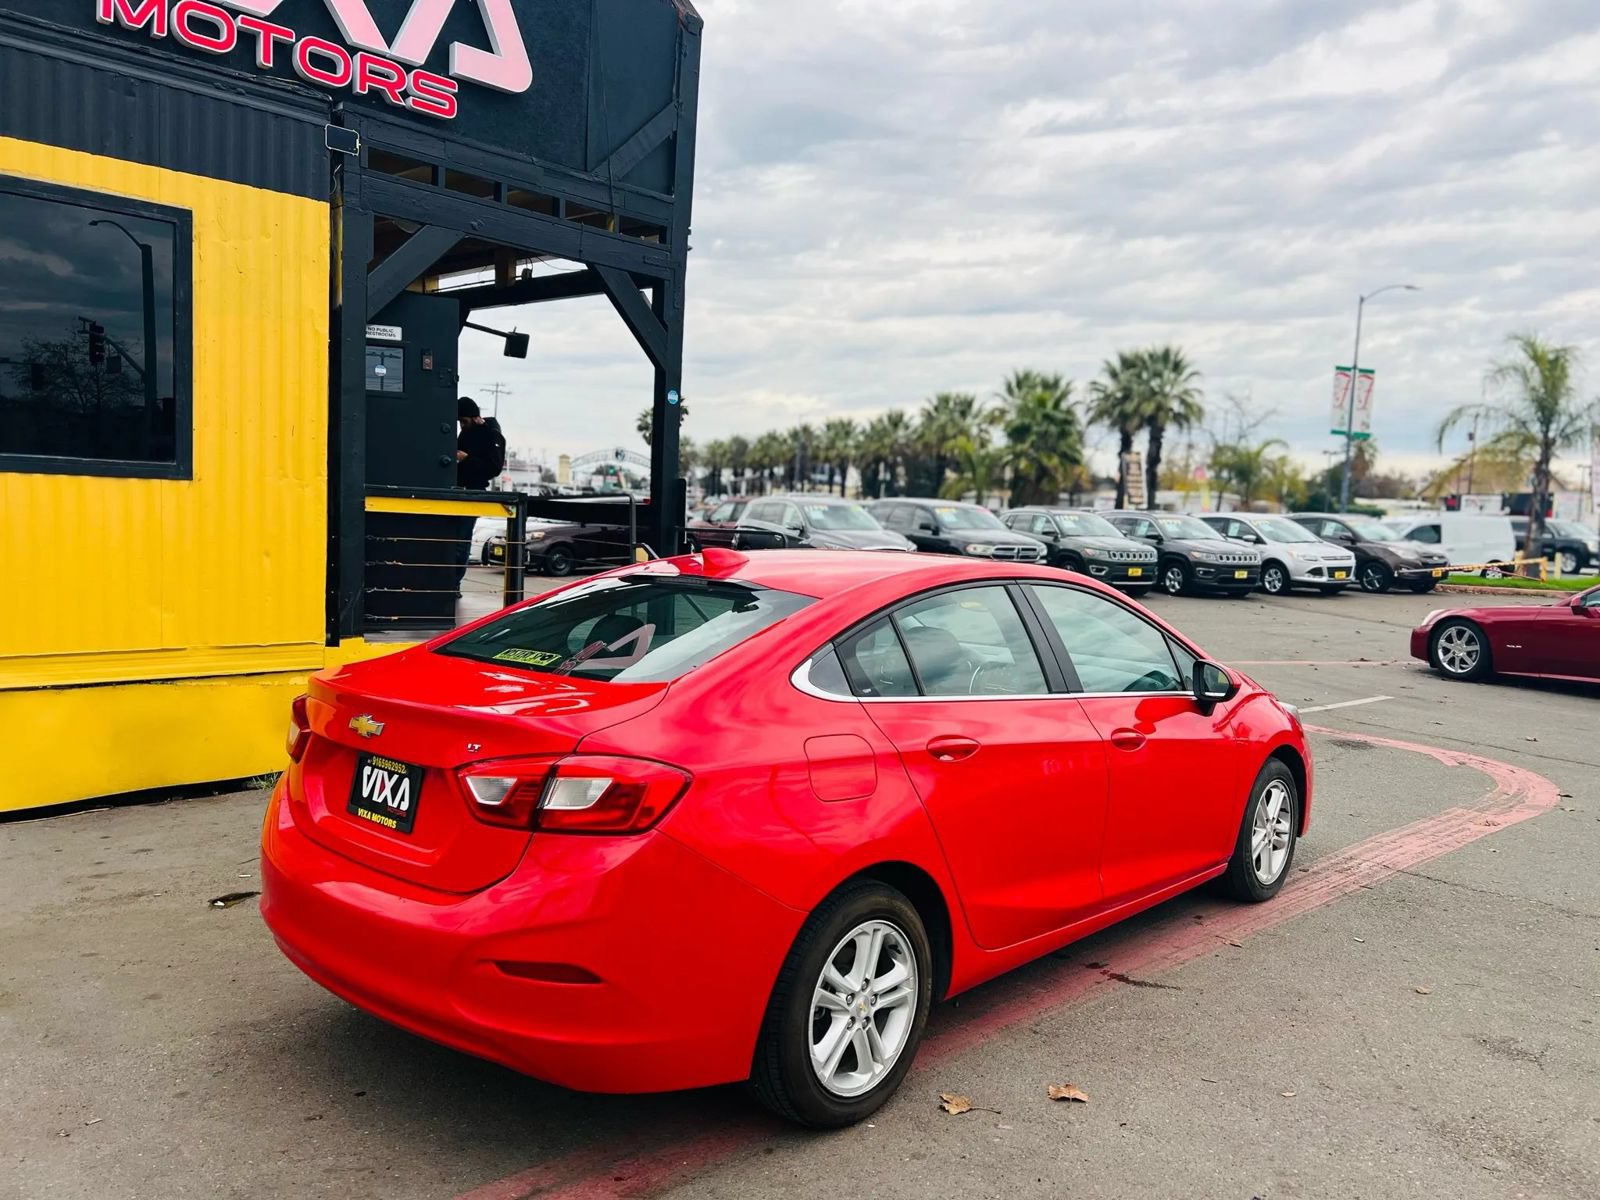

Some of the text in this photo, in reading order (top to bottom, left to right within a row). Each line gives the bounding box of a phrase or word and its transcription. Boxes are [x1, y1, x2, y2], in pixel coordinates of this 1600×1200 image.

[97, 0, 459, 119] MOTORS
[467, 743, 482, 753] LT
[362, 765, 410, 811] VIXA
[357, 807, 397, 829] VIXA MOTORS
